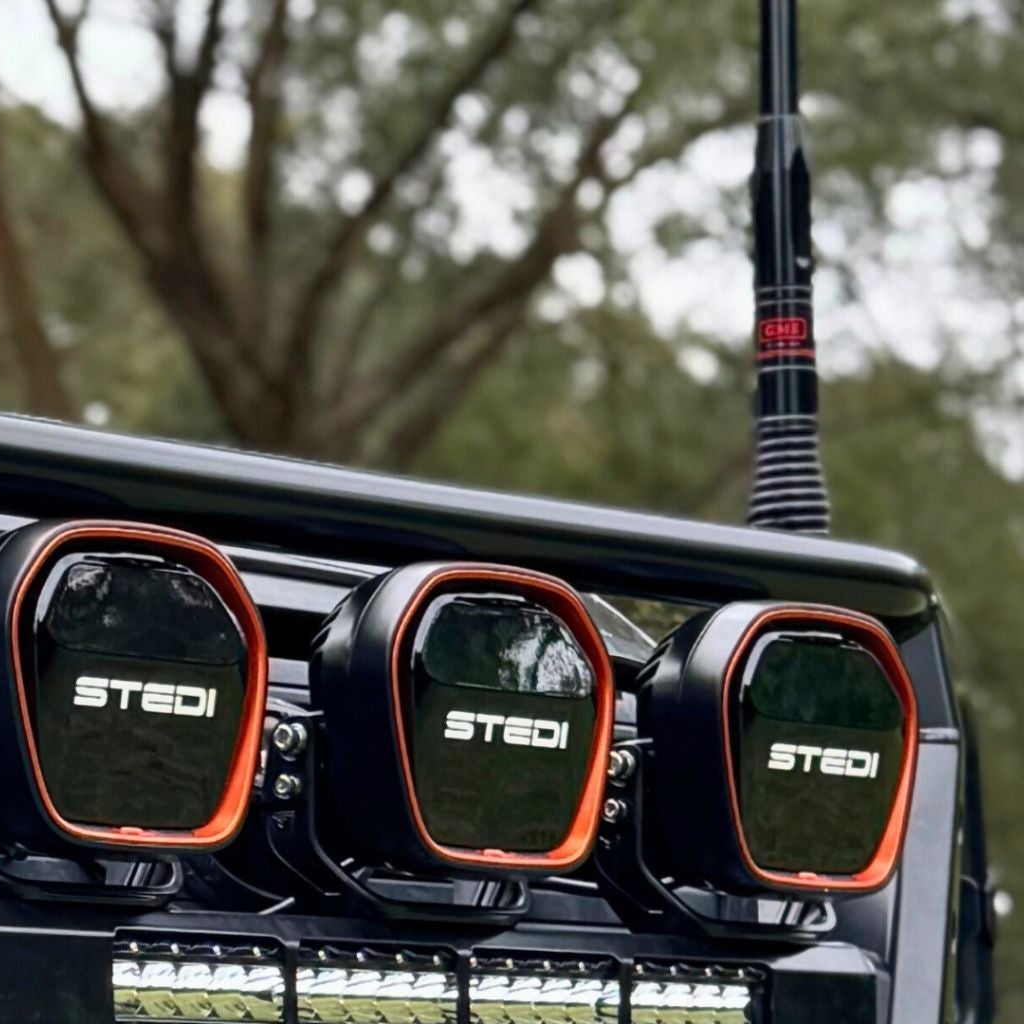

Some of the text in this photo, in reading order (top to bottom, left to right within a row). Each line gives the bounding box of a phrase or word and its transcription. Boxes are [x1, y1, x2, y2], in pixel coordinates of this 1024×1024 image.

[73, 676, 217, 718] STEDI
[444, 710, 570, 750] STEDI
[767, 743, 880, 779] STEDI
